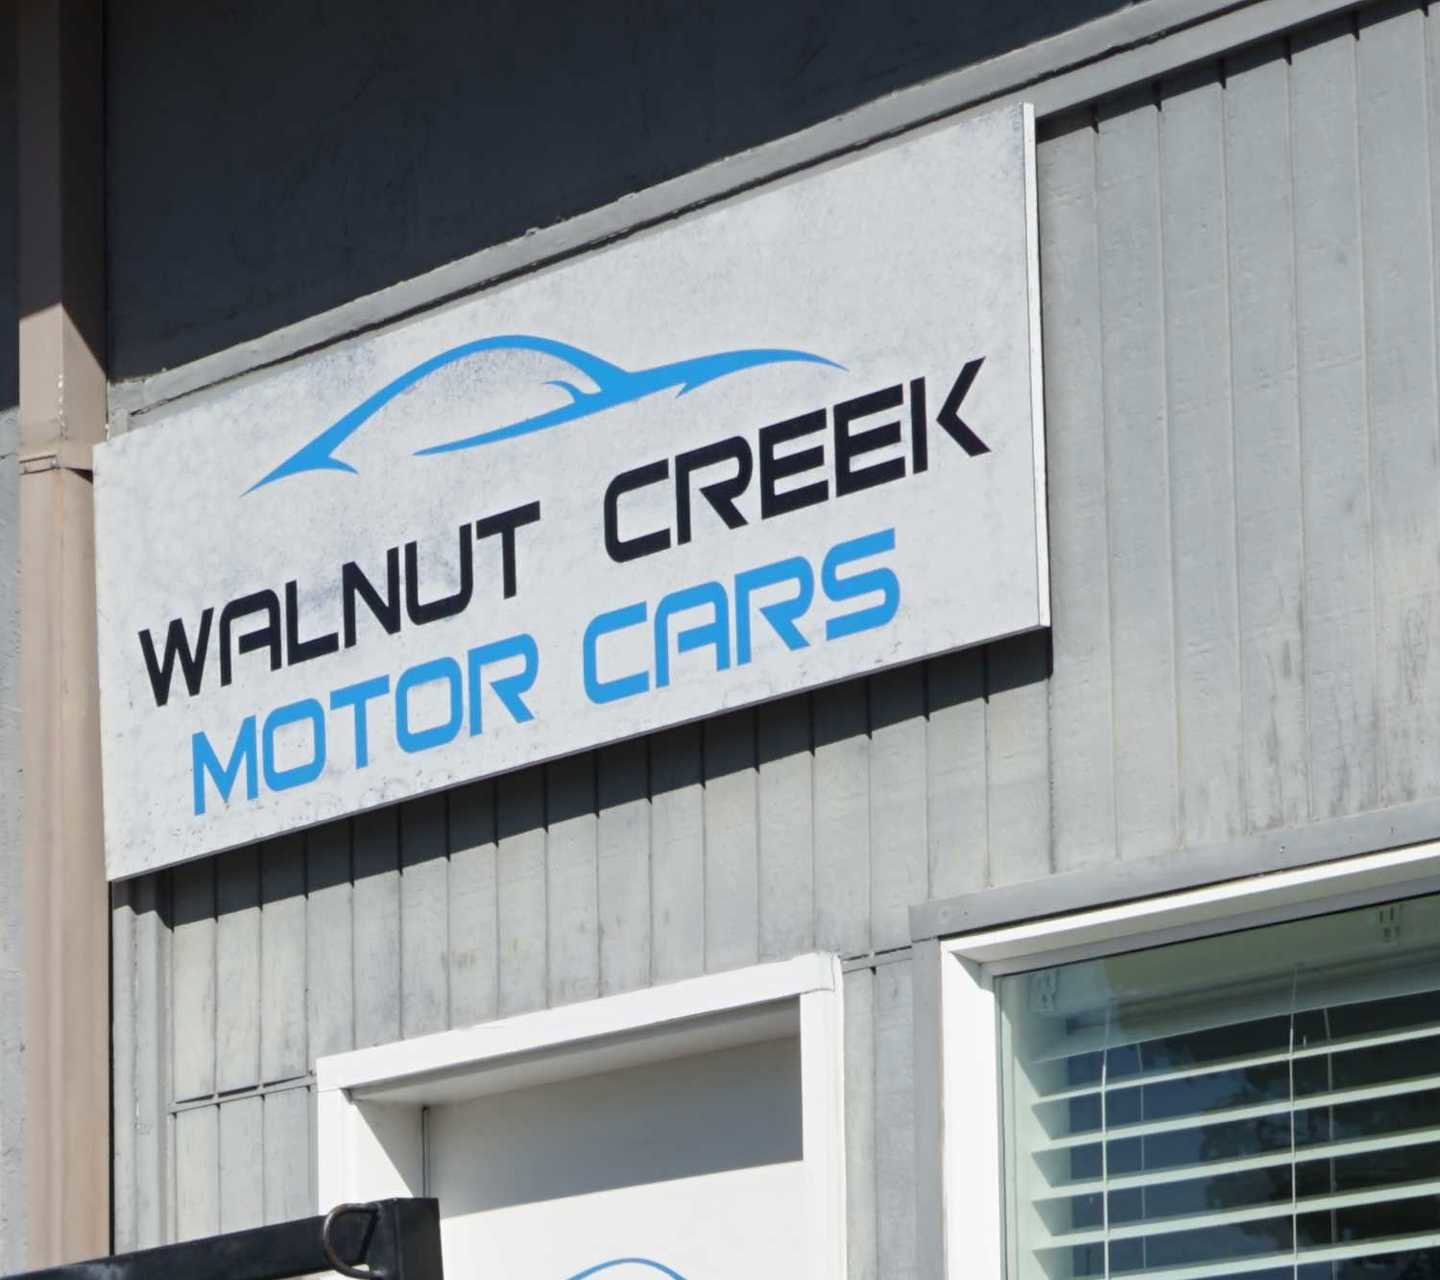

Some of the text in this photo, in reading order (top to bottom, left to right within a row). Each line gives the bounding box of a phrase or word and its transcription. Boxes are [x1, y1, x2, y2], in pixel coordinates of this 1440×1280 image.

[138, 355, 992, 707] WALNUT CREEK
[191, 526, 902, 816] MOTOR CARS
